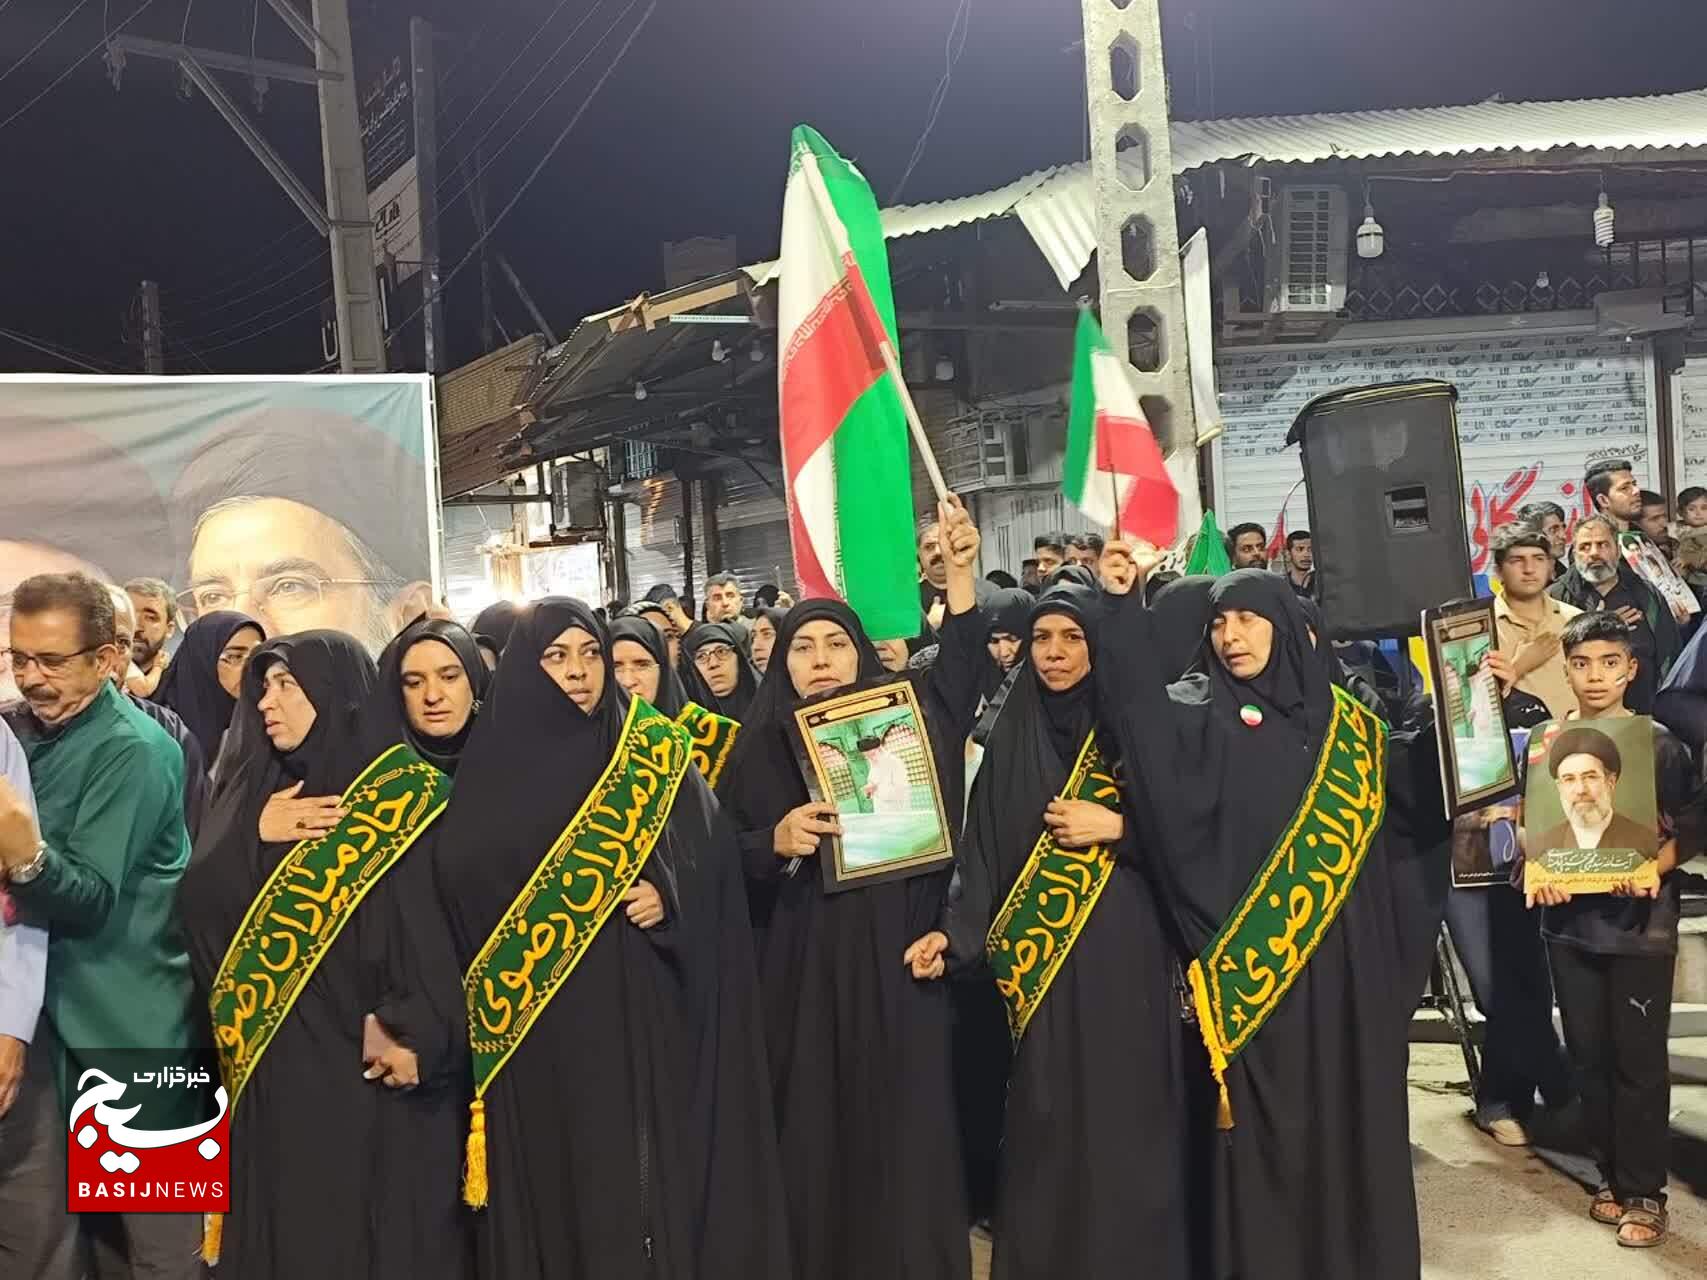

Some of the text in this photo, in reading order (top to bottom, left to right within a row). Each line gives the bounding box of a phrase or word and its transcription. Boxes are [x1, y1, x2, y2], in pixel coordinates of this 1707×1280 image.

[217, 789, 414, 1062] خادمیاران رضو
[478, 736, 673, 1035] خادمیاران رضوی
[996, 928, 1055, 1011] رضو
[1234, 855, 1334, 1005] رضوی
